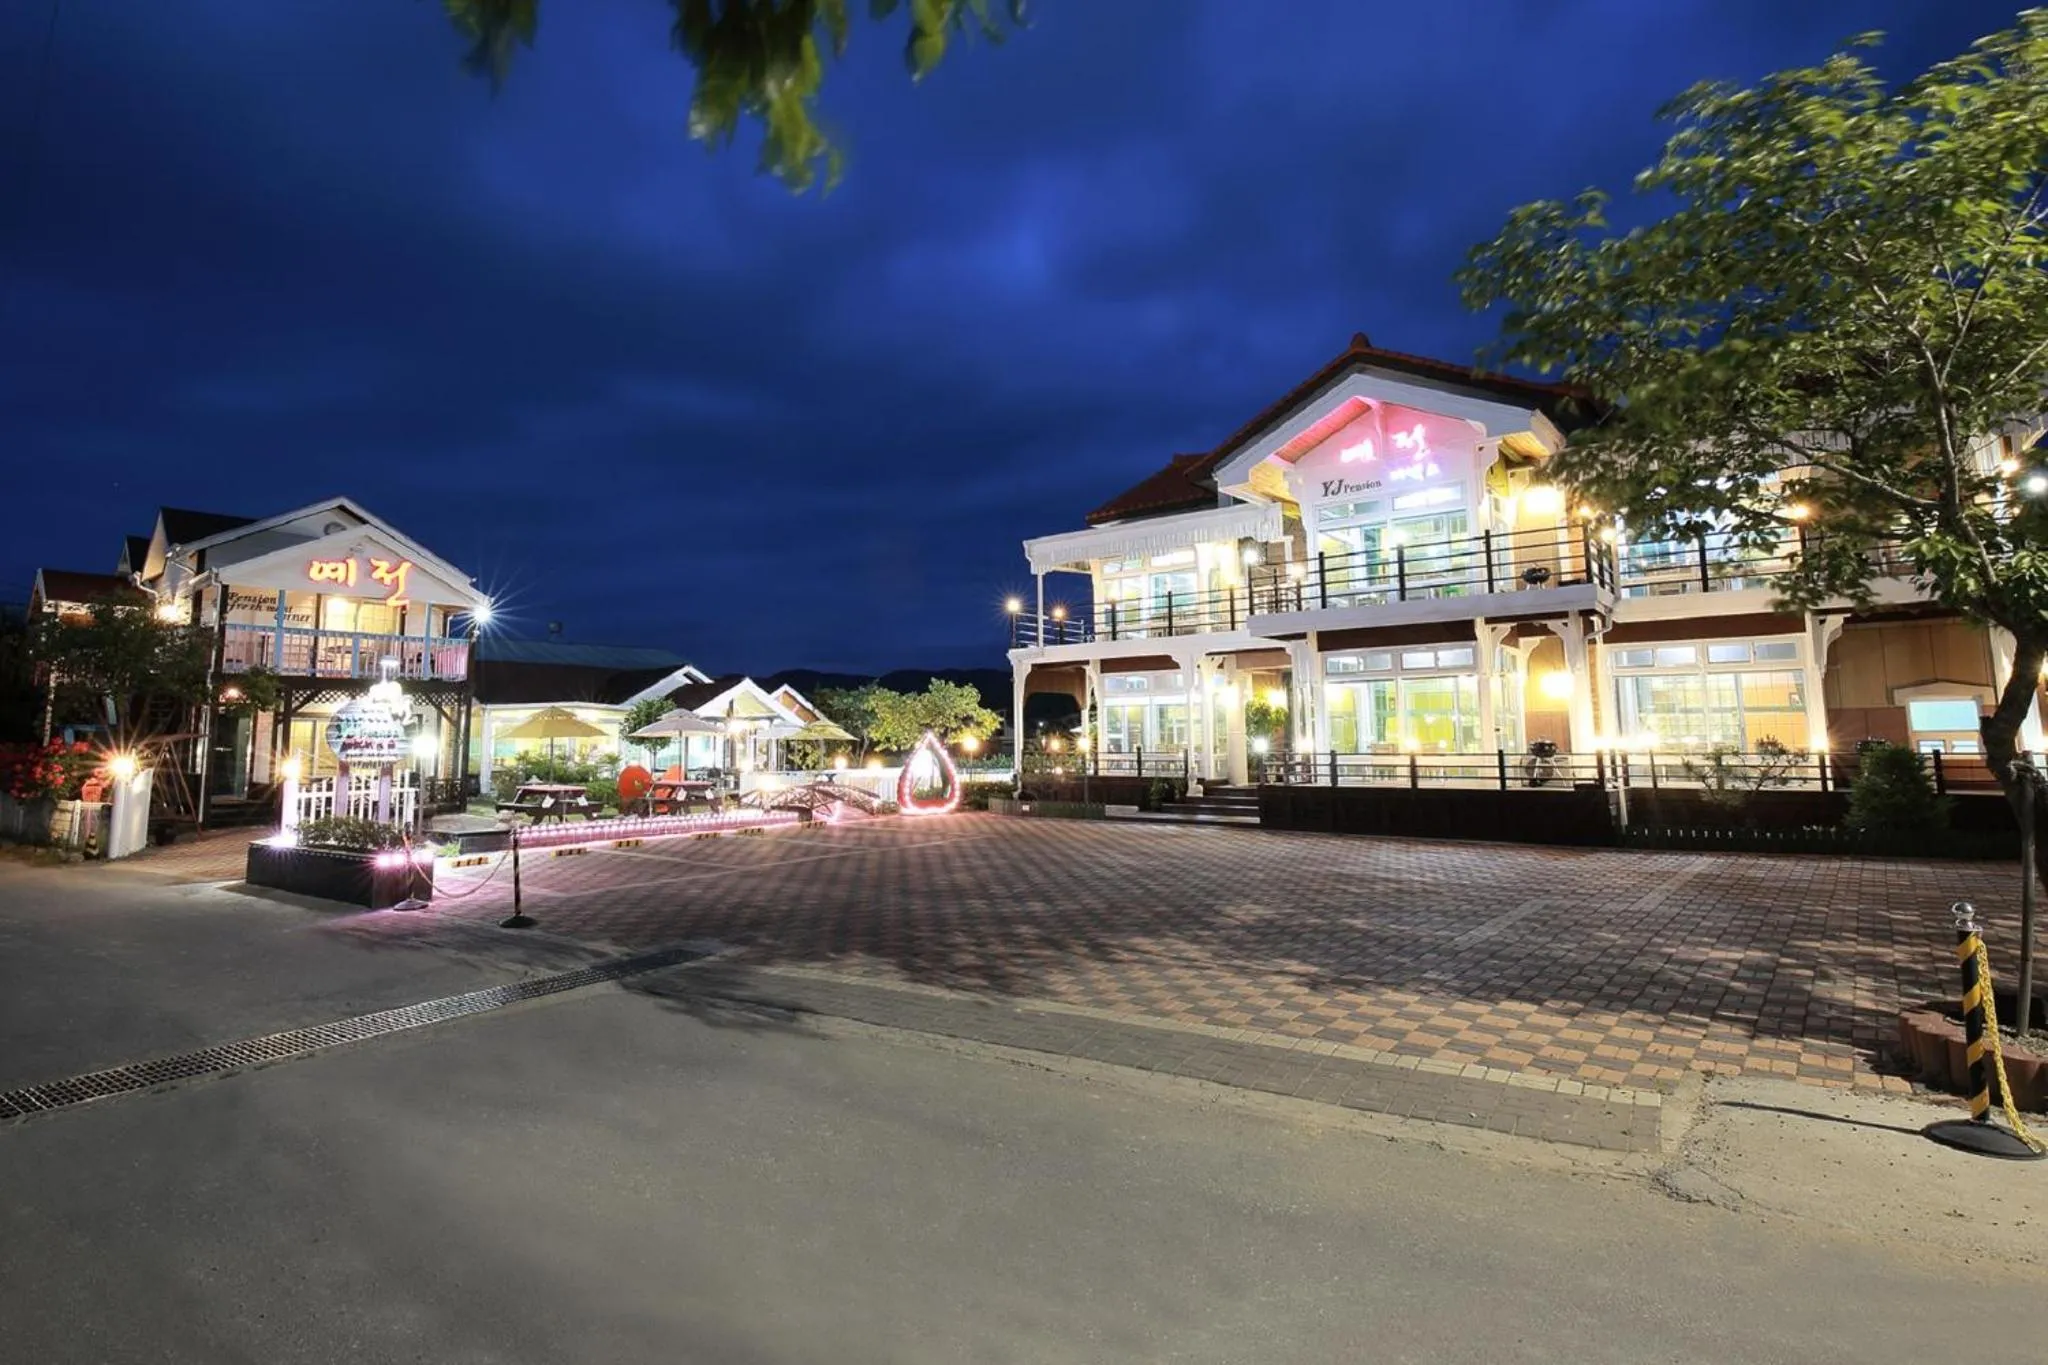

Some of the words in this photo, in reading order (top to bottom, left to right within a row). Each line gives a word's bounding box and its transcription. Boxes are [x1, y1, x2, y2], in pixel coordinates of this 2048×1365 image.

[1321, 479, 1344, 497] YJ
[1344, 480, 1382, 494] Pension
[228, 592, 277, 604] Pension
[229, 602, 262, 612] fresh
[273, 613, 311, 622] crner
